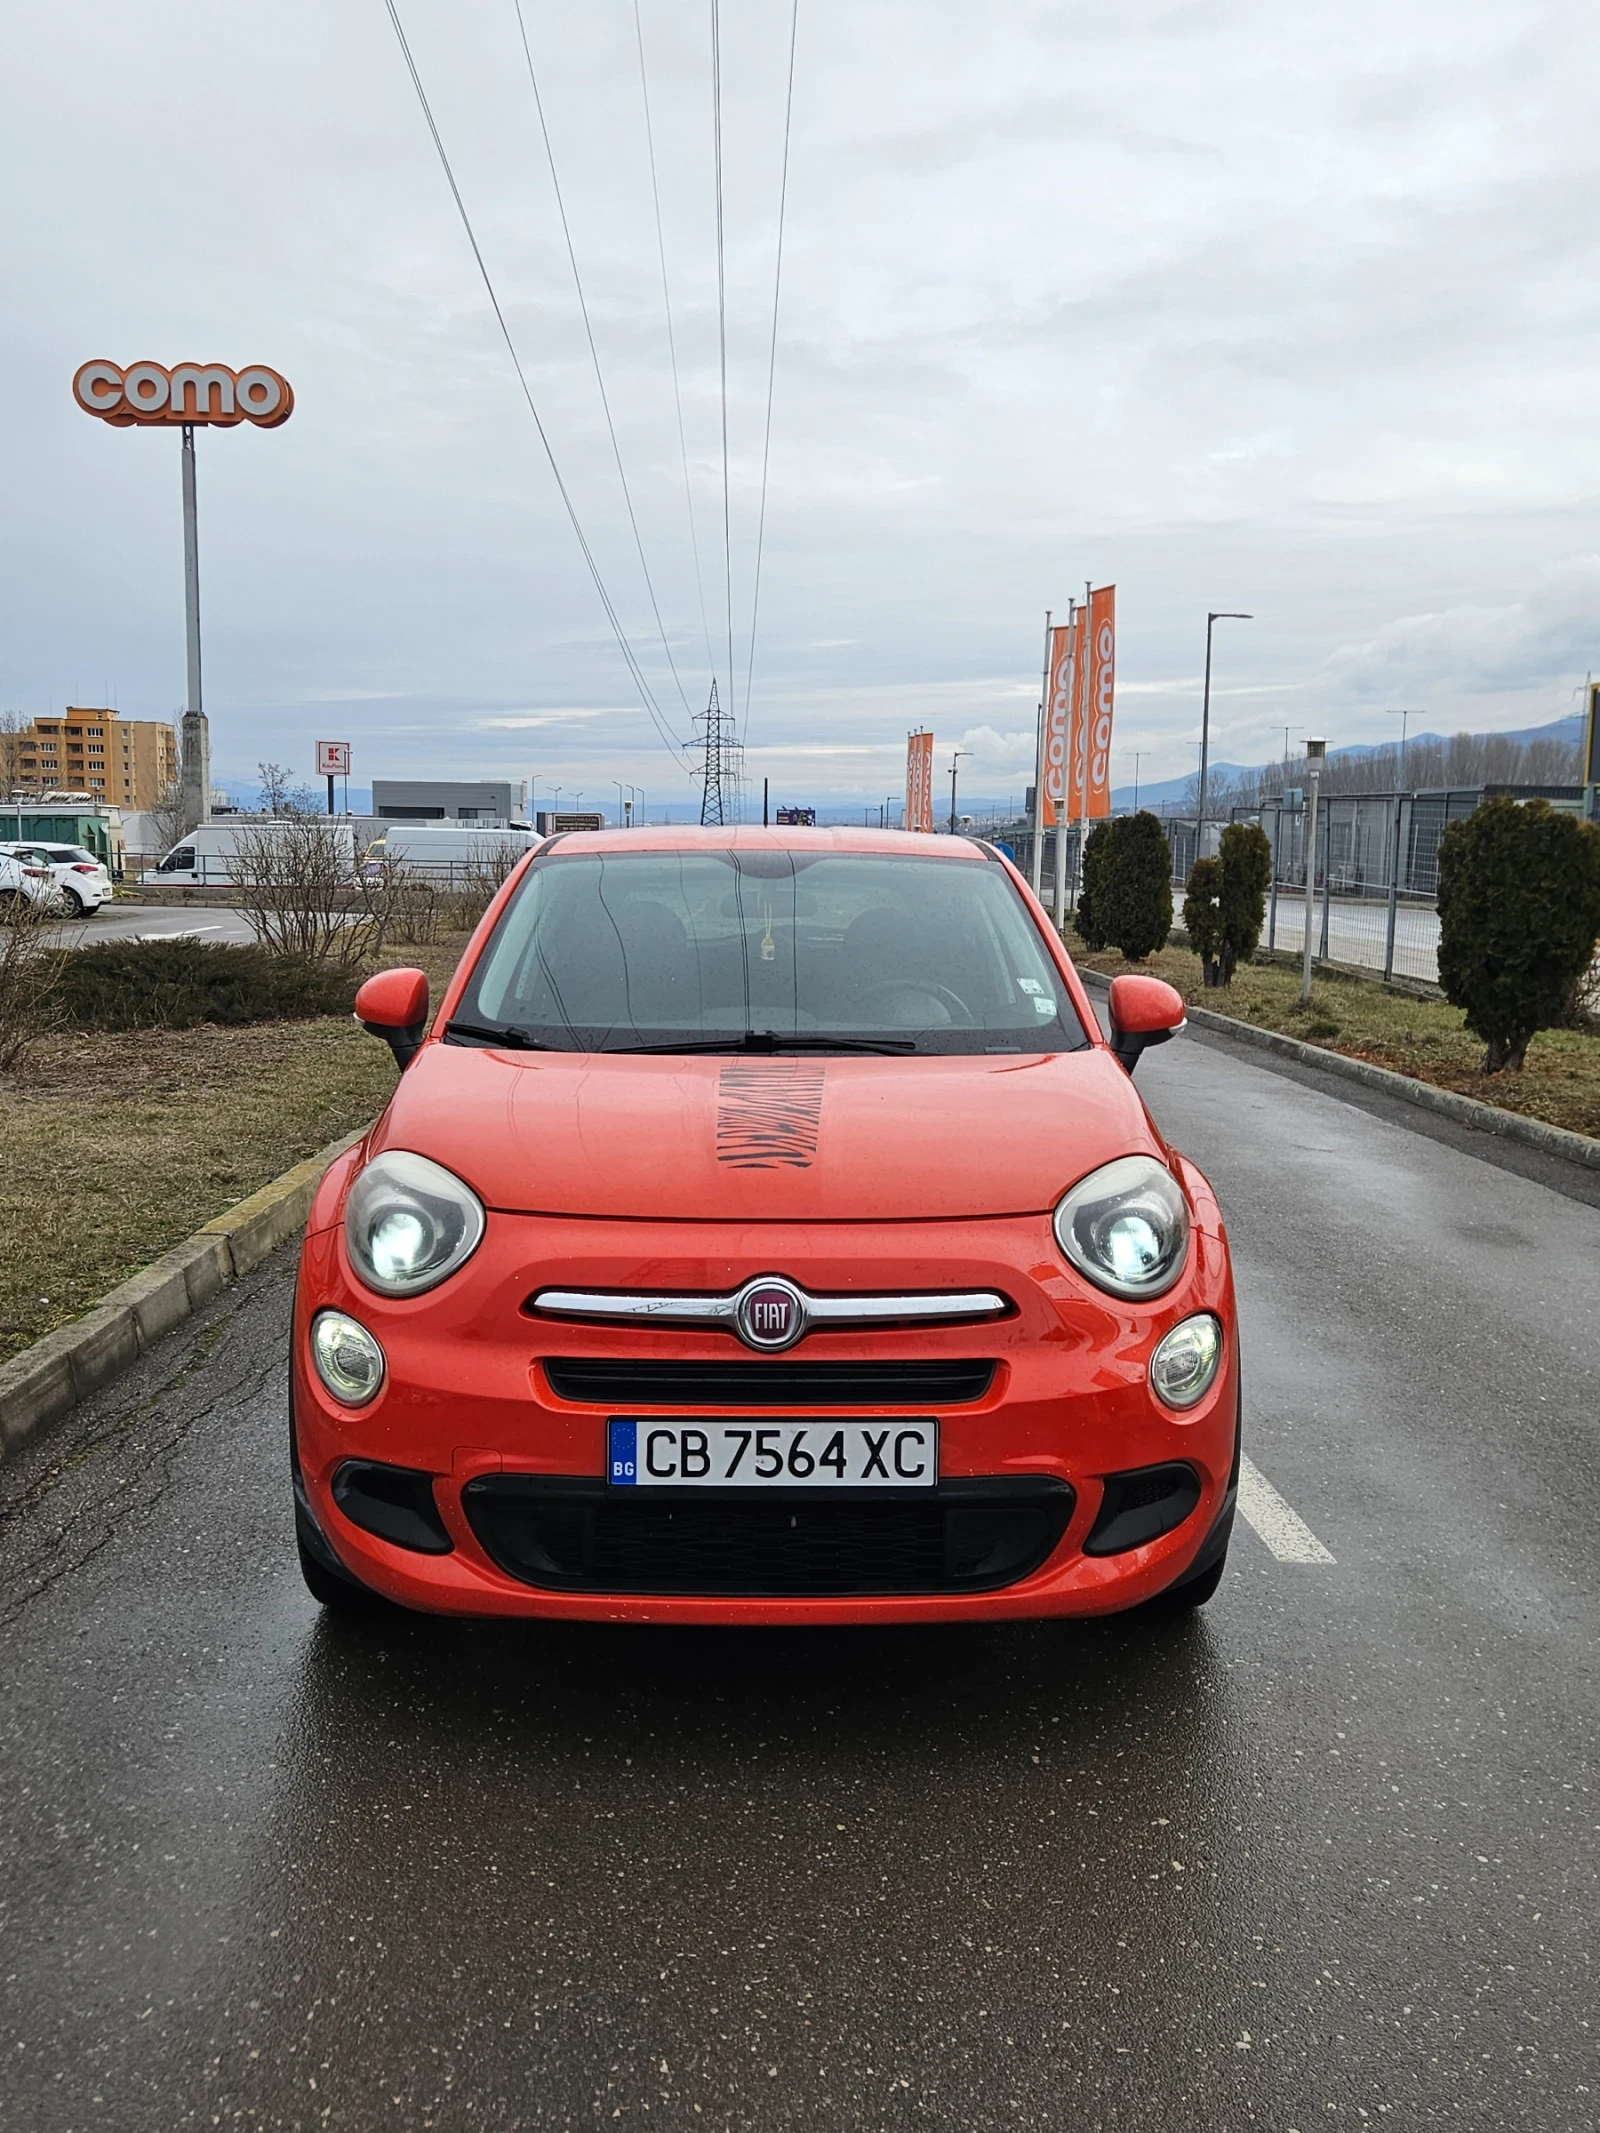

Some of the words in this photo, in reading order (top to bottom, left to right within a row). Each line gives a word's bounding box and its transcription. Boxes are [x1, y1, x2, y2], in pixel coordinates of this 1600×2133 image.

[78, 365, 281, 416] como
[1048, 659, 1075, 798] como
[1092, 626, 1113, 786] como
[754, 1303, 788, 1329] FIAT
[613, 1462, 634, 1476] BG
[646, 1430, 711, 1478] CB
[724, 1430, 847, 1479] 7564
[861, 1430, 925, 1479] XC
